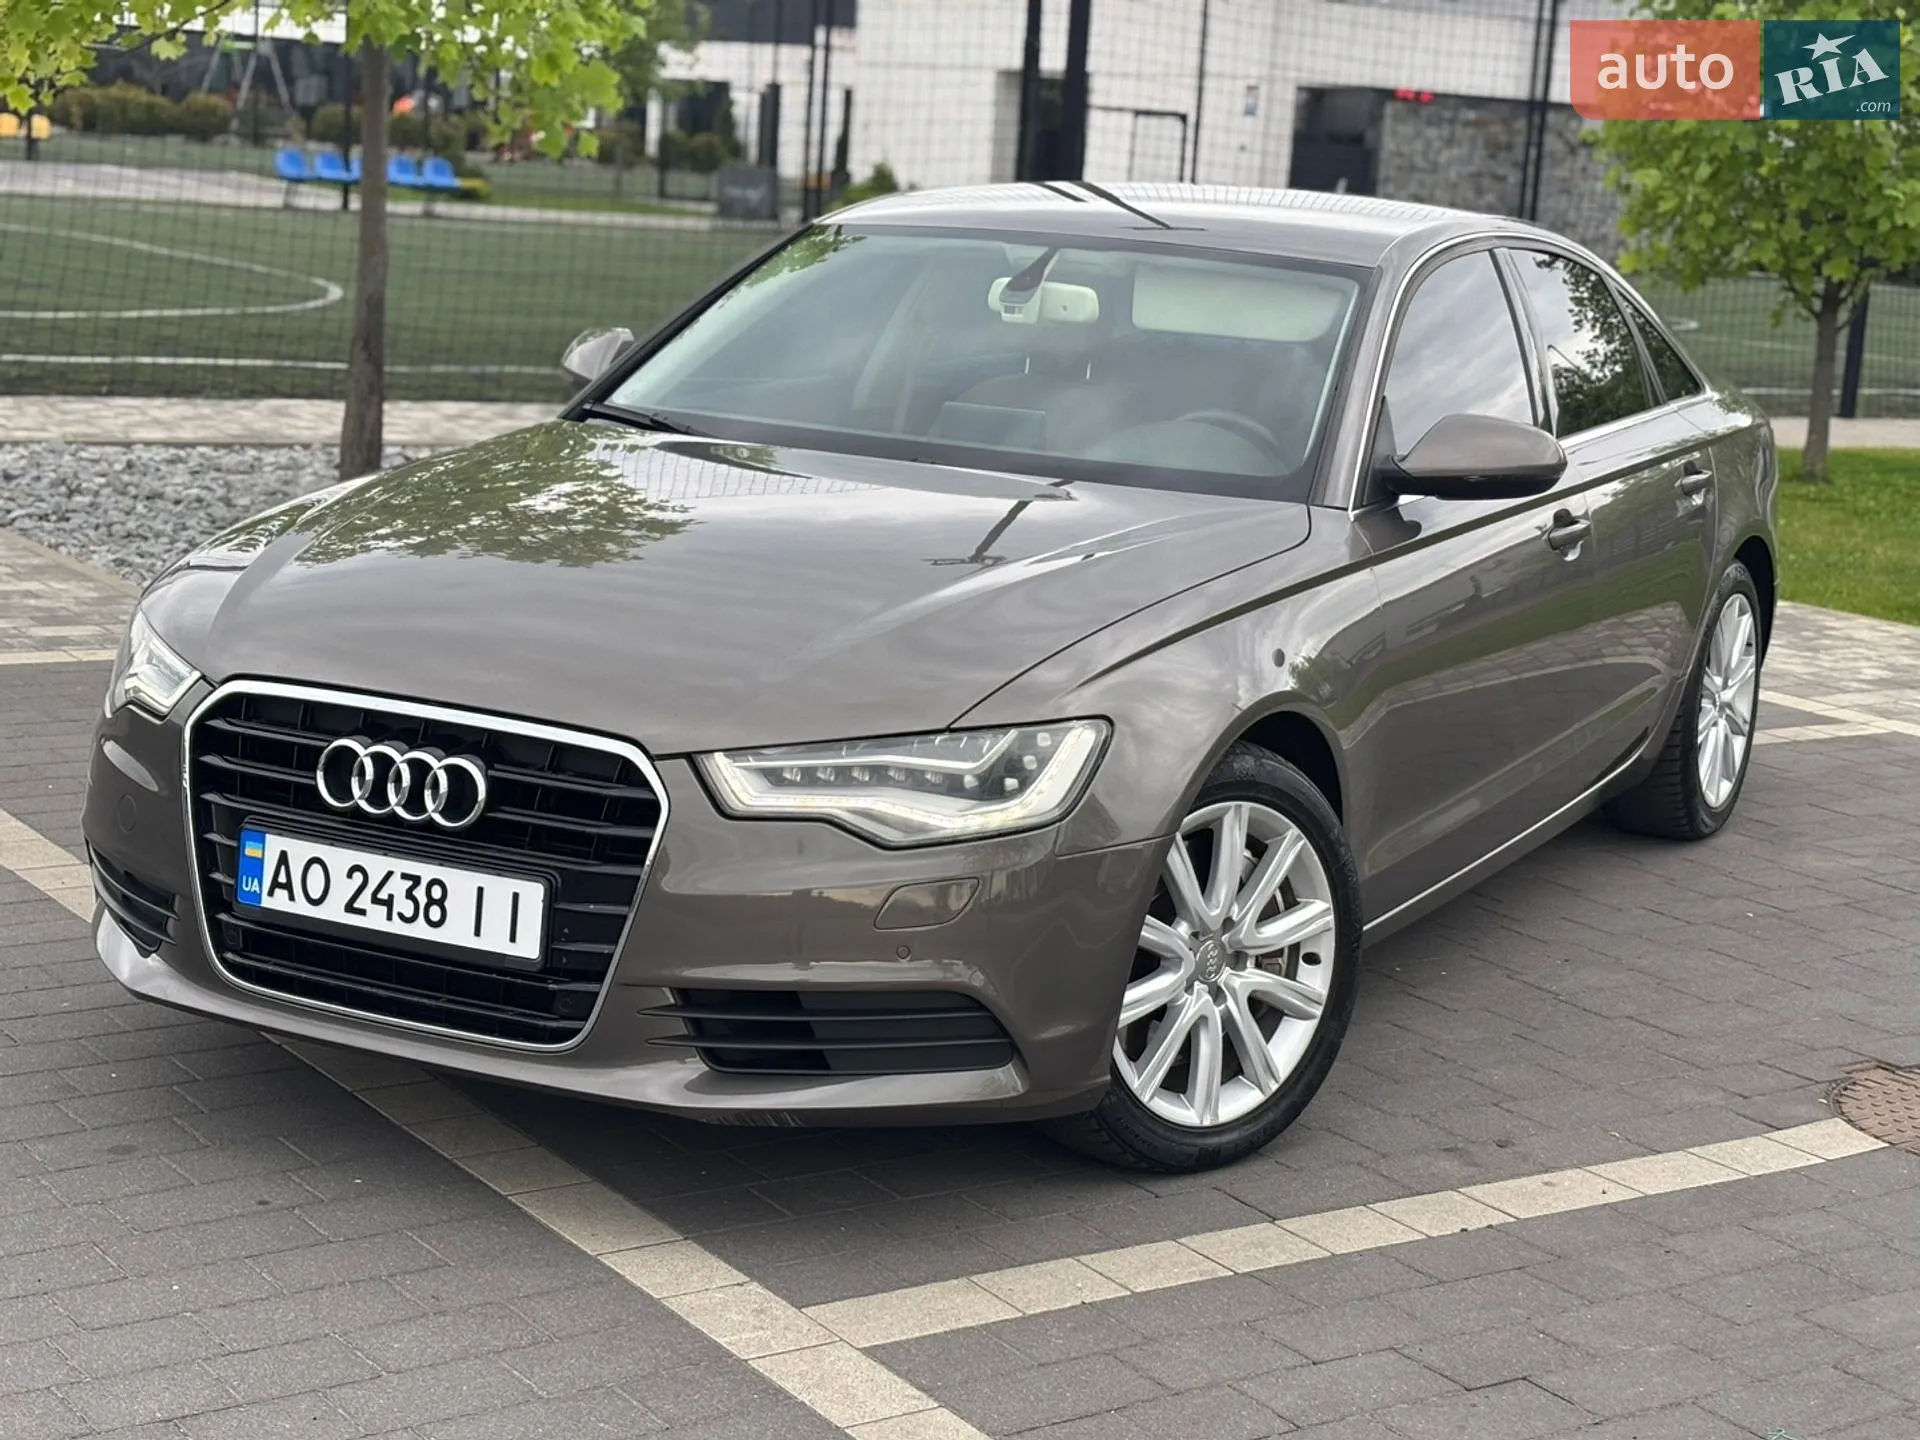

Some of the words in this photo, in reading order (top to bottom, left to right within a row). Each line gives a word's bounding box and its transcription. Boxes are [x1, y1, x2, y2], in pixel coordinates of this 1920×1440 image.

[241, 874, 260, 894] UA
[267, 849, 331, 907] AO
[343, 864, 449, 929] 2438
